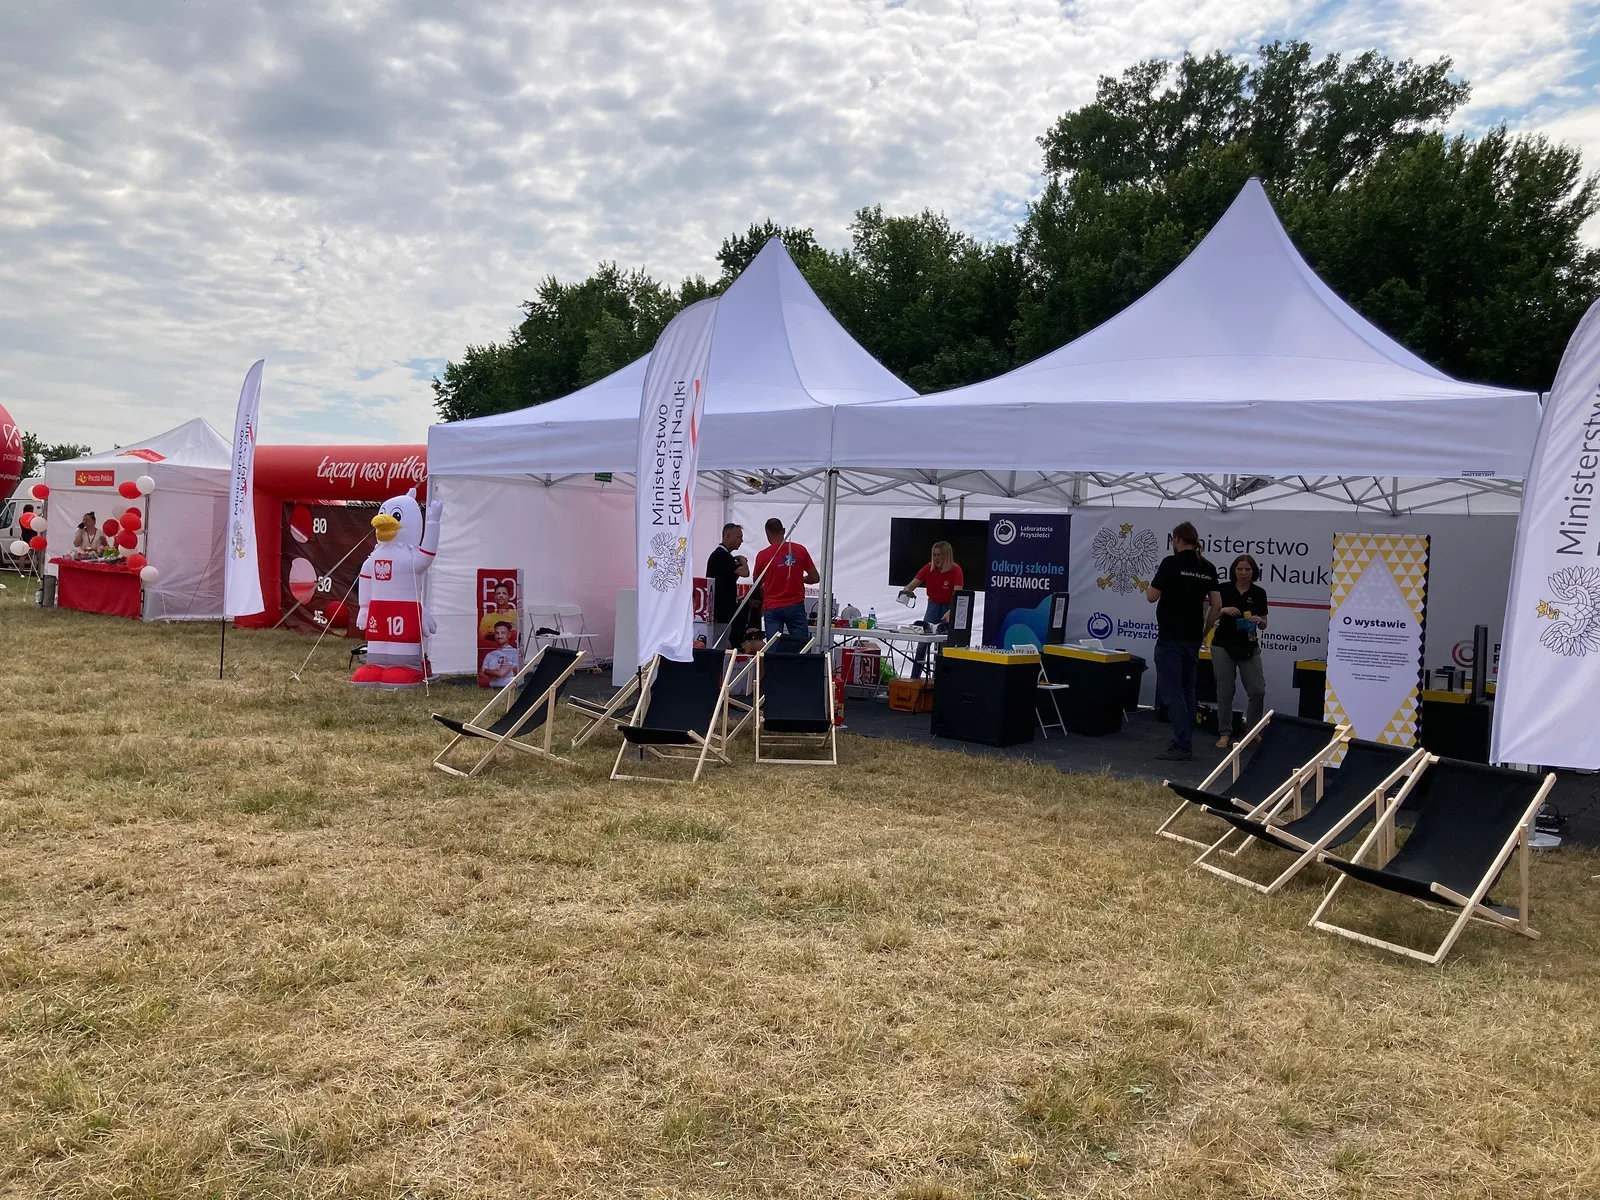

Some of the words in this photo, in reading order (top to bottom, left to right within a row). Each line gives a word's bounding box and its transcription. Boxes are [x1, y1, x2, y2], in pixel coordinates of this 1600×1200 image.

[672, 380, 685, 434] Nauki
[316, 455, 360, 488] Łączy
[360, 462, 387, 482] nas
[652, 404, 668, 526] Ministerstwo
[1556, 383, 1600, 556] Ministerstw
[313, 518, 327, 534] 80
[991, 560, 1024, 575] Odkryj
[1025, 562, 1065, 575] szkolne
[1270, 564, 1329, 586] Nauk
[990, 575, 1050, 590] SUPERMOCE
[386, 616, 404, 636] 10
[1117, 619, 1159, 631] Laborato
[1343, 616, 1352, 625] O
[1354, 619, 1406, 629] wystawie
[1117, 628, 1159, 639] Przyszło
[1260, 631, 1321, 644] innowacyjna
[1260, 641, 1298, 652] historia
